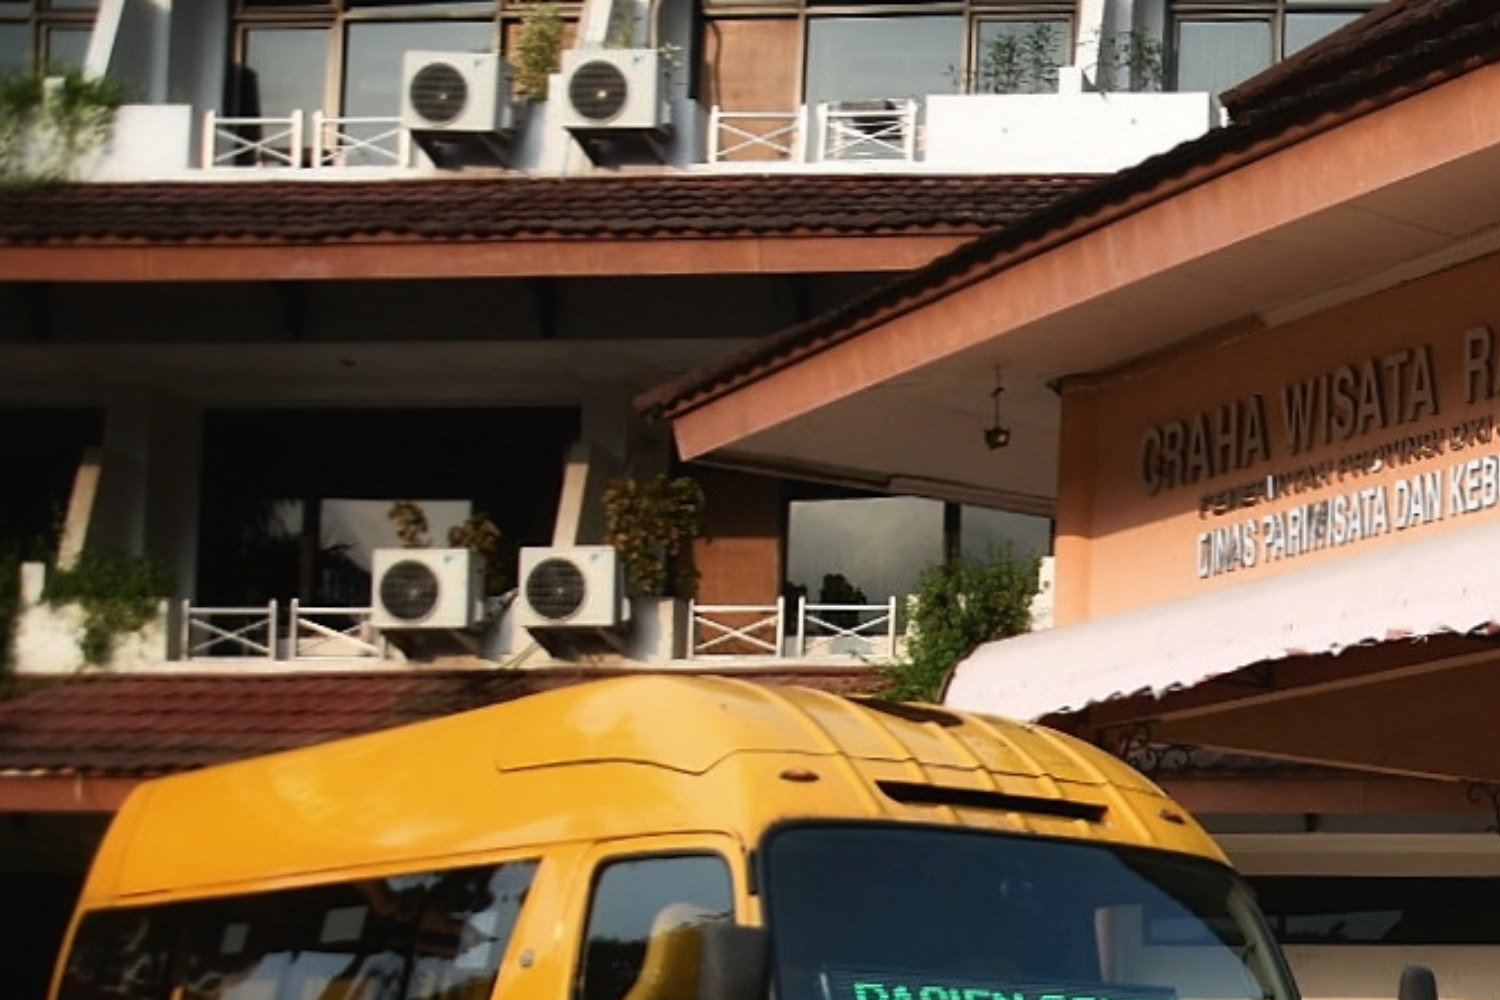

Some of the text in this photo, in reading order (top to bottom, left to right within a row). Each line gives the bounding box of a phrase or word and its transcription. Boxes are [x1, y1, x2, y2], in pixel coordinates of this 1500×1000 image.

[1140, 393, 1271, 496] GRAHA
[1282, 345, 1440, 455] WISATA
[1394, 469, 1444, 531] DAN
